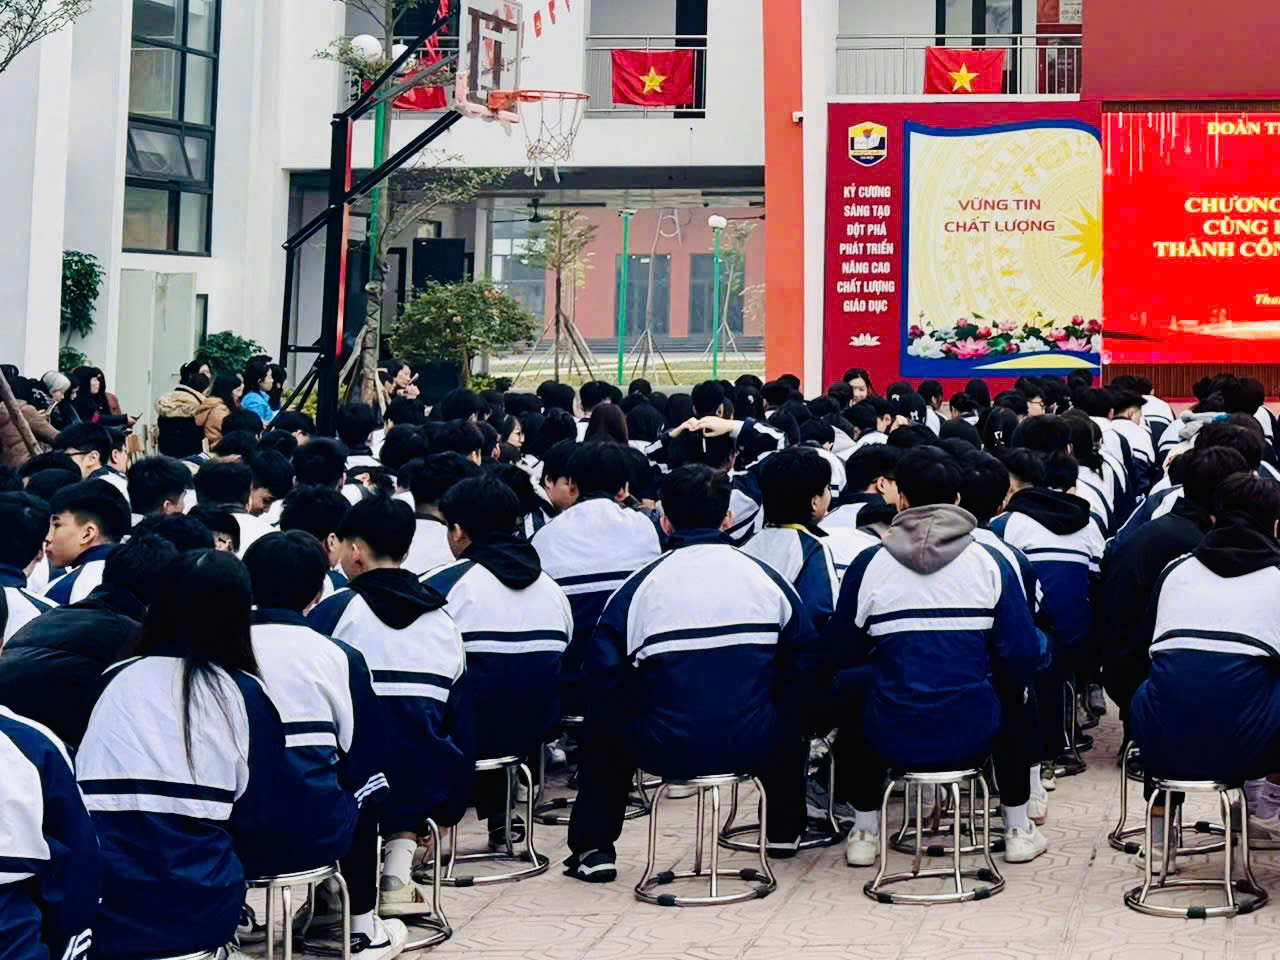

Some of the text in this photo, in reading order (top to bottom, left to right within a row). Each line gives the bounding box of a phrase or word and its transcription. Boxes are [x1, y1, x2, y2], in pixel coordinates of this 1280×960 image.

[1207, 117, 1260, 135] ĐOÀN
[858, 185, 892, 198] CƯƠNG
[843, 202, 891, 219] SÁNG TẠO
[958, 196, 1041, 211] VỮNG TIN
[867, 221, 887, 236] PHÁ
[944, 216, 1056, 235] CHẤT LƯỢNG
[1203, 216, 1269, 235] CÙNG
[839, 240, 864, 255] PHÁT
[1153, 238, 1236, 257] THÀNH
[871, 261, 891, 274] CAO
[837, 276, 896, 295] CHẤT LƯỢNG
[843, 297, 888, 315] GIÁO DỤC
